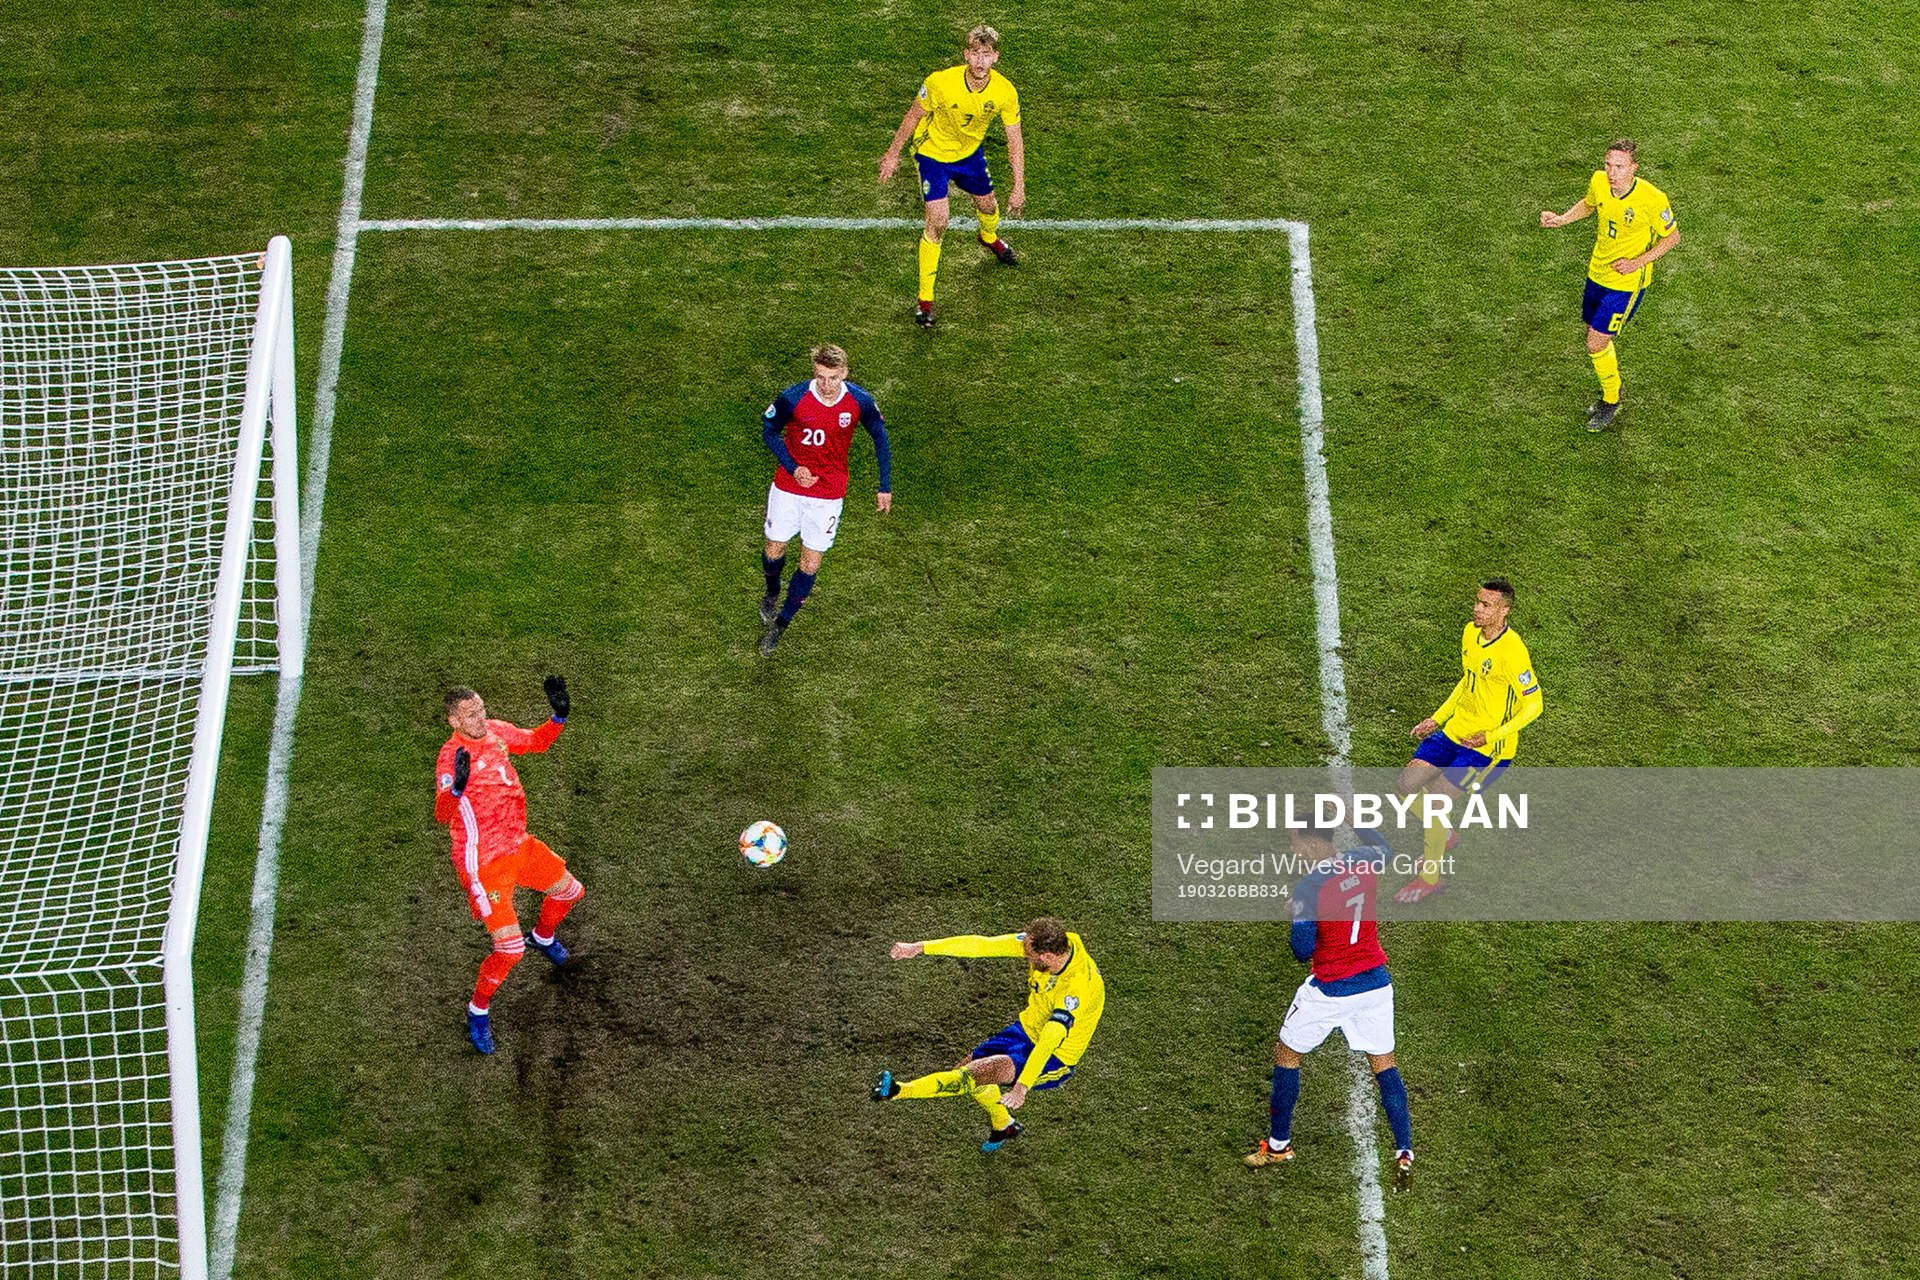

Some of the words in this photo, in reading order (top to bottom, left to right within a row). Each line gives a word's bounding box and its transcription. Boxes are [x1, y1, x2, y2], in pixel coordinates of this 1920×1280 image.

[1608, 220, 1617, 240] 6
[1608, 312, 1623, 332] 6
[800, 428, 826, 446] 20
[1338, 875, 1361, 892] KING
[1345, 892, 1365, 945] 7
